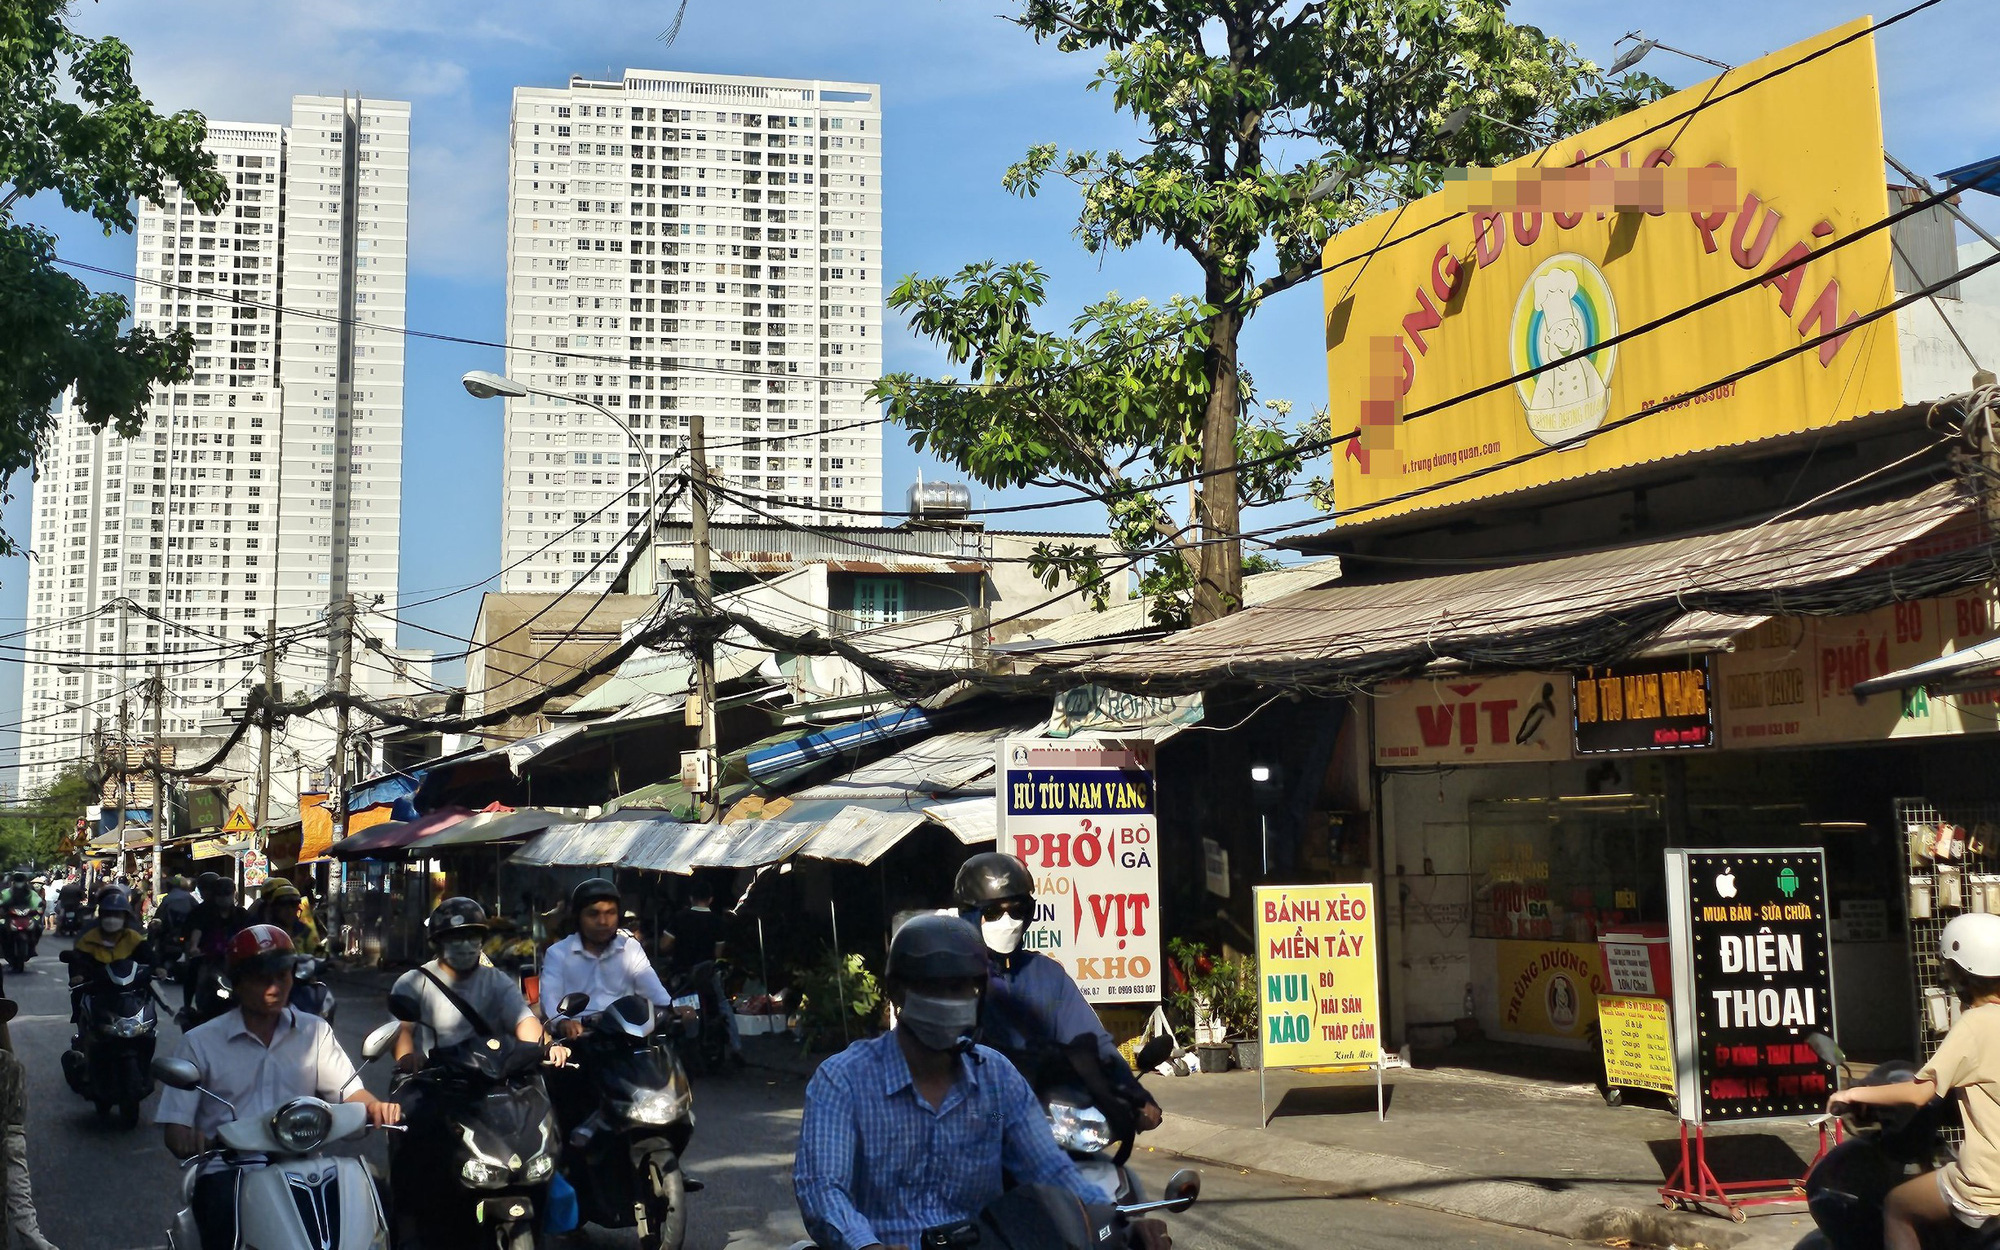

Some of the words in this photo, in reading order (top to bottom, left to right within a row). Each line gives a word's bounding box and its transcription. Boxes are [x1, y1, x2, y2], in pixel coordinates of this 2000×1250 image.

[1416, 699, 1518, 754] VỊT
[1013, 772, 1036, 810] HỦ
[1069, 782, 1103, 809] NAM
[1105, 782, 1148, 809] VANG
[1012, 818, 1102, 868] PHỞ
[1121, 823, 1151, 845] BÒ
[1121, 847, 1152, 869] GÀ
[1087, 893, 1150, 950] VỊT
[1265, 894, 1320, 923] BÁNH
[1326, 893, 1366, 922] XÈO
[1703, 906, 1728, 922] MUA
[1729, 903, 1752, 922] BÁN
[1760, 900, 1782, 921] SỬA
[1784, 902, 1812, 920] CHỮA
[1270, 926, 1319, 959] MIỀN
[1324, 929, 1364, 958] TÂY
[1719, 926, 1804, 981] ĐIỆN
[1076, 956, 1151, 980] KHO
[1319, 970, 1334, 988] BÒ
[1267, 974, 1309, 1003] NUI
[1507, 961, 1539, 1025] TRÙNG
[1540, 947, 1589, 988] DƯƠNG
[1268, 1011, 1310, 1044] XÀO
[1712, 987, 1816, 1035] THOẠI
